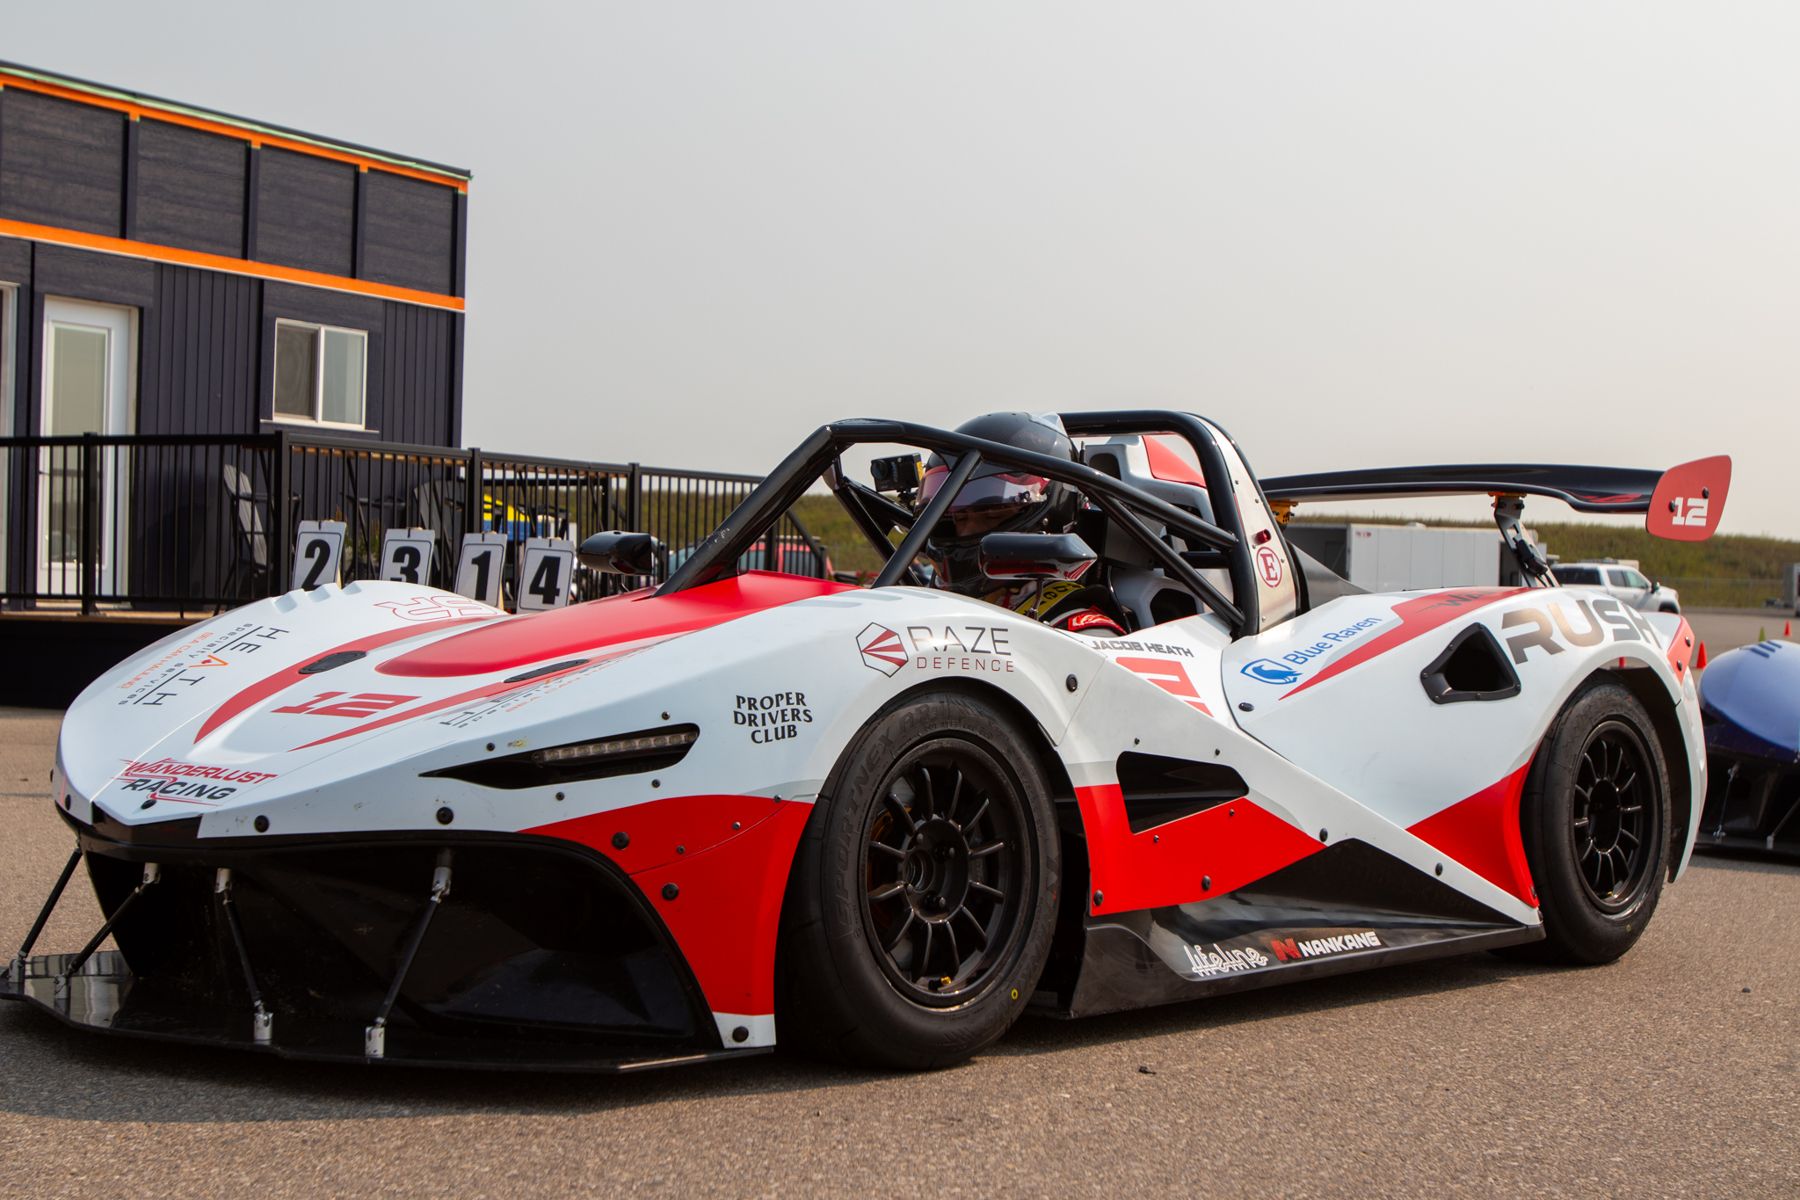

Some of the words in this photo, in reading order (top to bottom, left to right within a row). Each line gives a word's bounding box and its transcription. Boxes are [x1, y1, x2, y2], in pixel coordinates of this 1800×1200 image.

[1672, 497, 1708, 527] 12
[305, 539, 331, 590] 2
[390, 546, 421, 583] 3
[471, 551, 492, 601] 1
[1261, 553, 1279, 582] E
[529, 556, 561, 605] 4
[906, 626, 1012, 656] RAZE
[1289, 635, 1332, 666] Blue
[1333, 617, 1382, 649] Raven
[1502, 599, 1663, 665] RUSH
[1092, 640, 1144, 652] JACOB
[1144, 642, 1194, 658] HEATH
[916, 656, 1015, 673] DEFENCE
[270, 691, 422, 718] 12
[735, 691, 807, 711] PROPER
[734, 708, 813, 728] DRIVERS
[751, 725, 798, 744] CLUB
[124, 759, 278, 784] WANDERLUST
[122, 778, 238, 800] RACING
[1299, 932, 1382, 957] NANKANG
